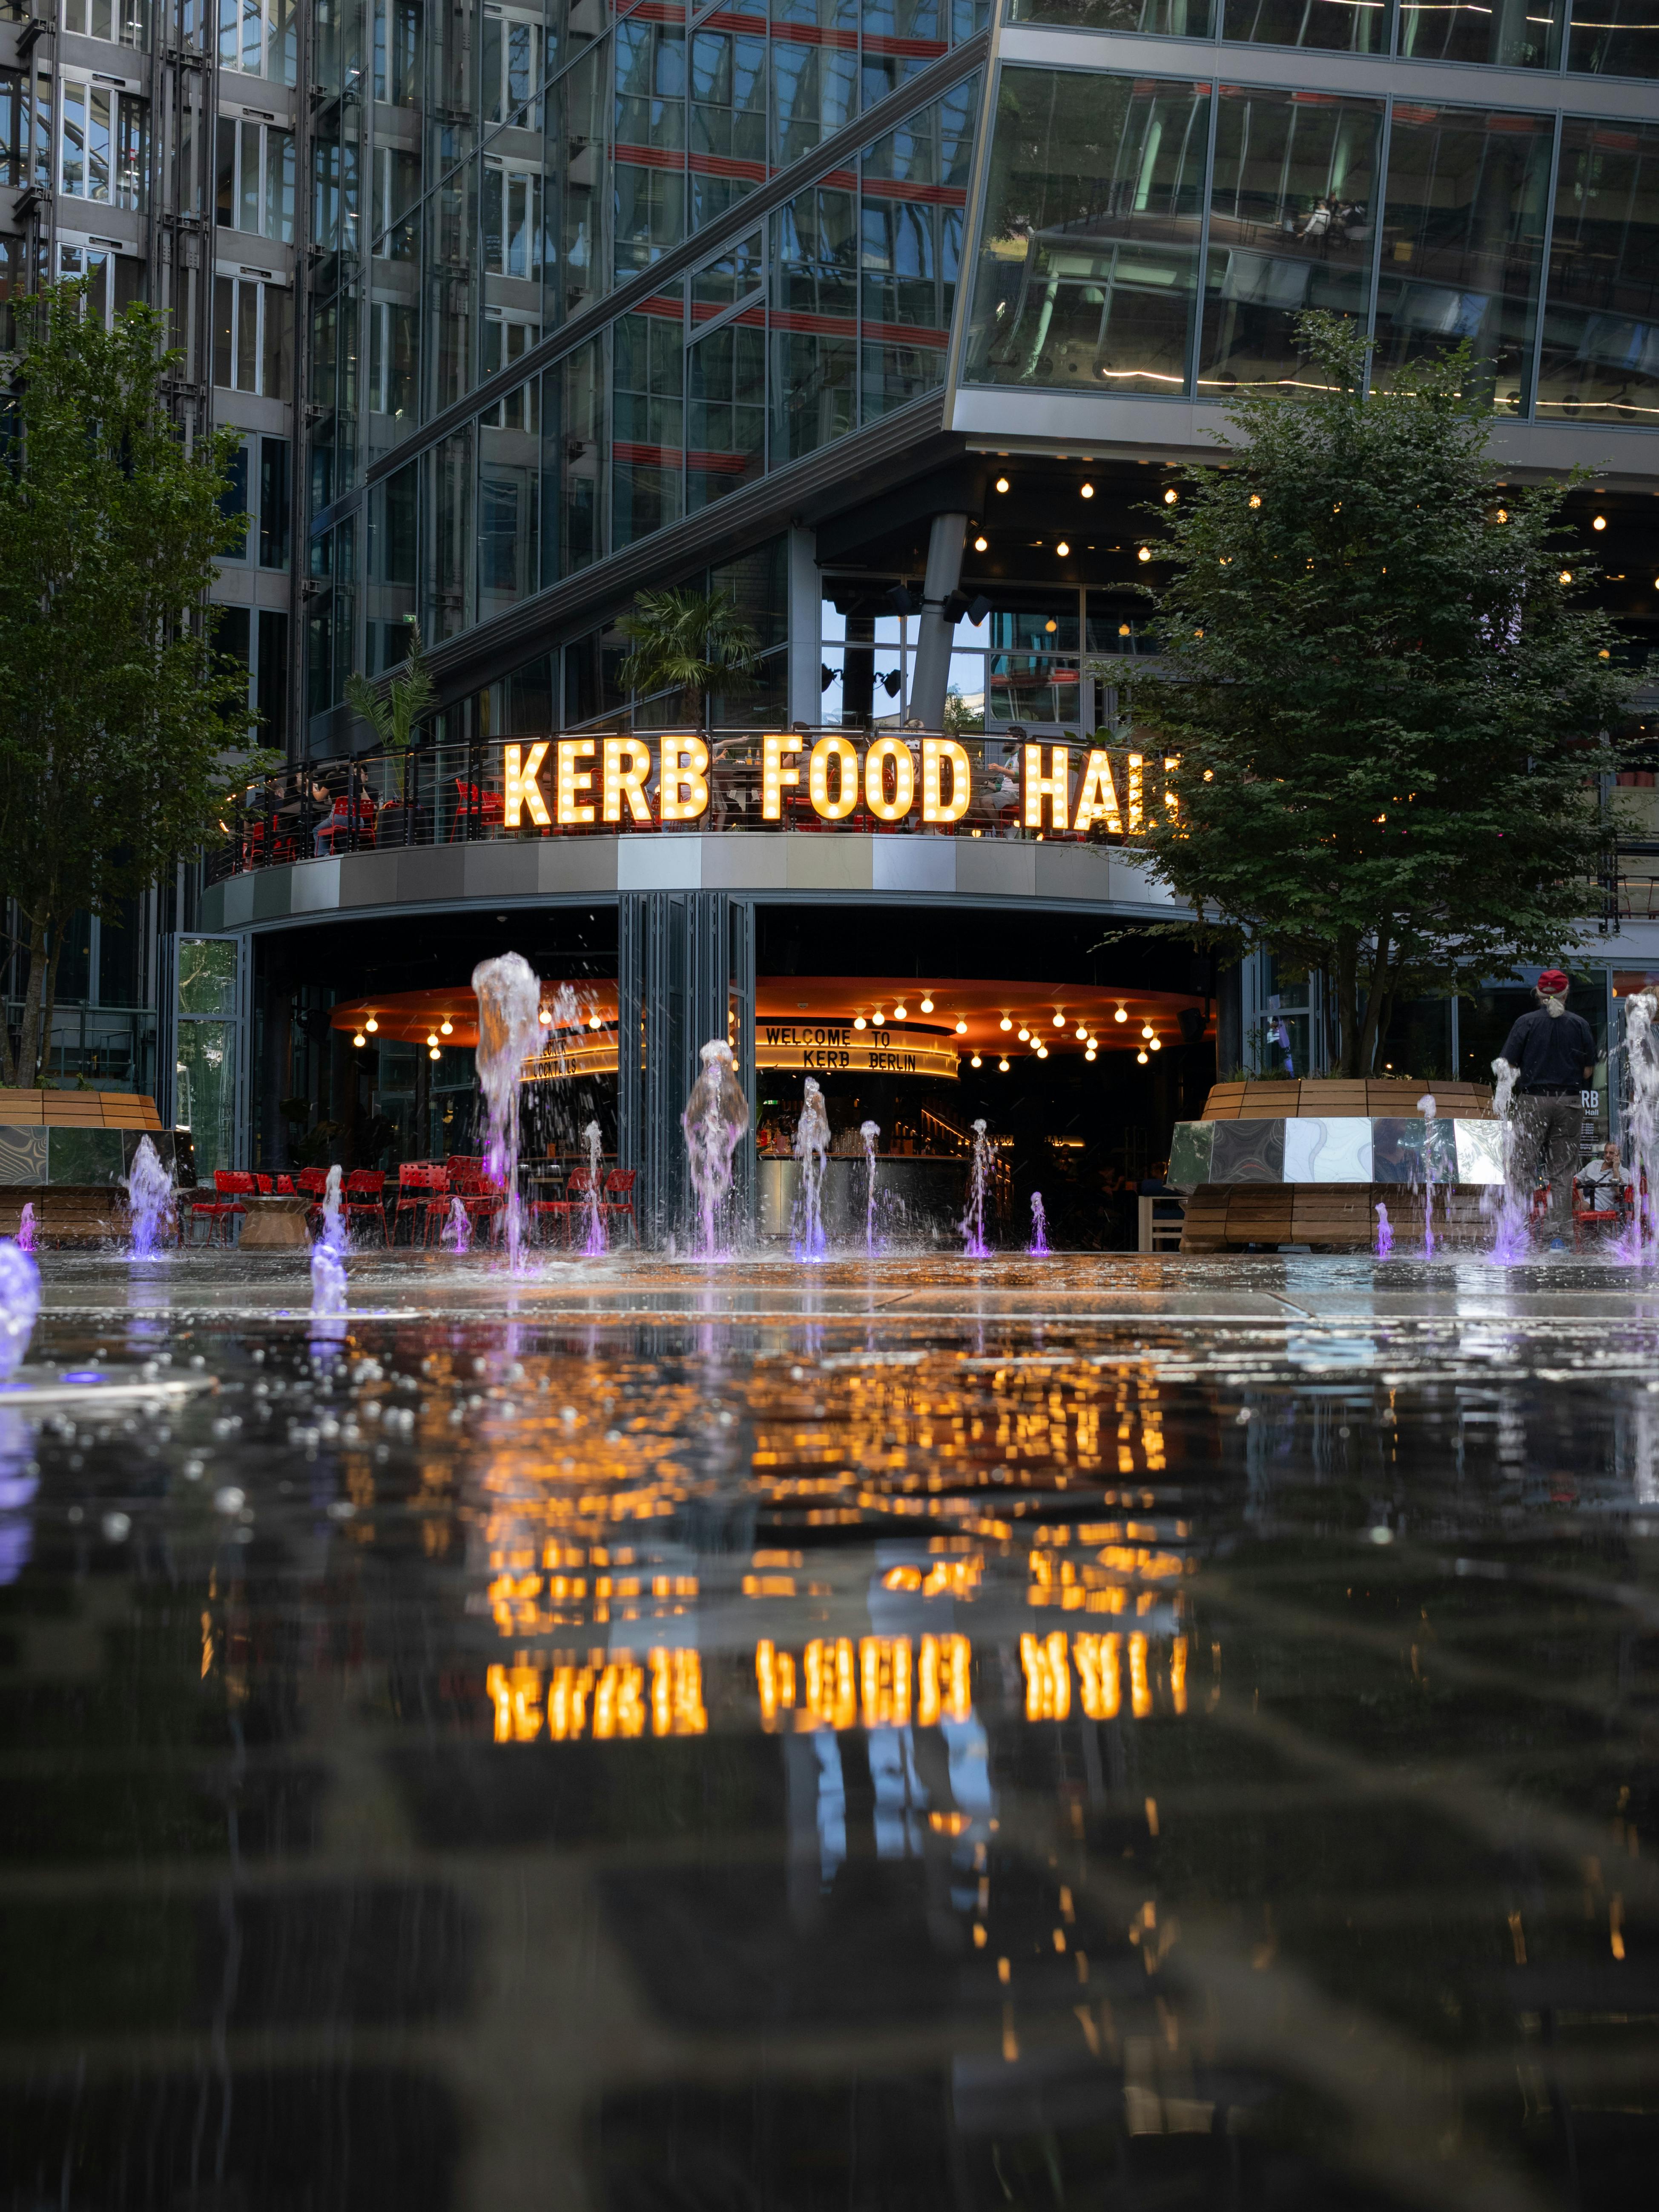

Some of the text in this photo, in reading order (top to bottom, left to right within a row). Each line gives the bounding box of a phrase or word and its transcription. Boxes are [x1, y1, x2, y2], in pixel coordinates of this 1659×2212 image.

[504, 736, 709, 827] KERB
[762, 735, 971, 823] FOOD
[766, 1027, 890, 1048] WELCOME TO
[540, 1039, 567, 1058] ECKER
[804, 1050, 916, 1072] KERB BERLIN
[1579, 1090, 1599, 1108] RB
